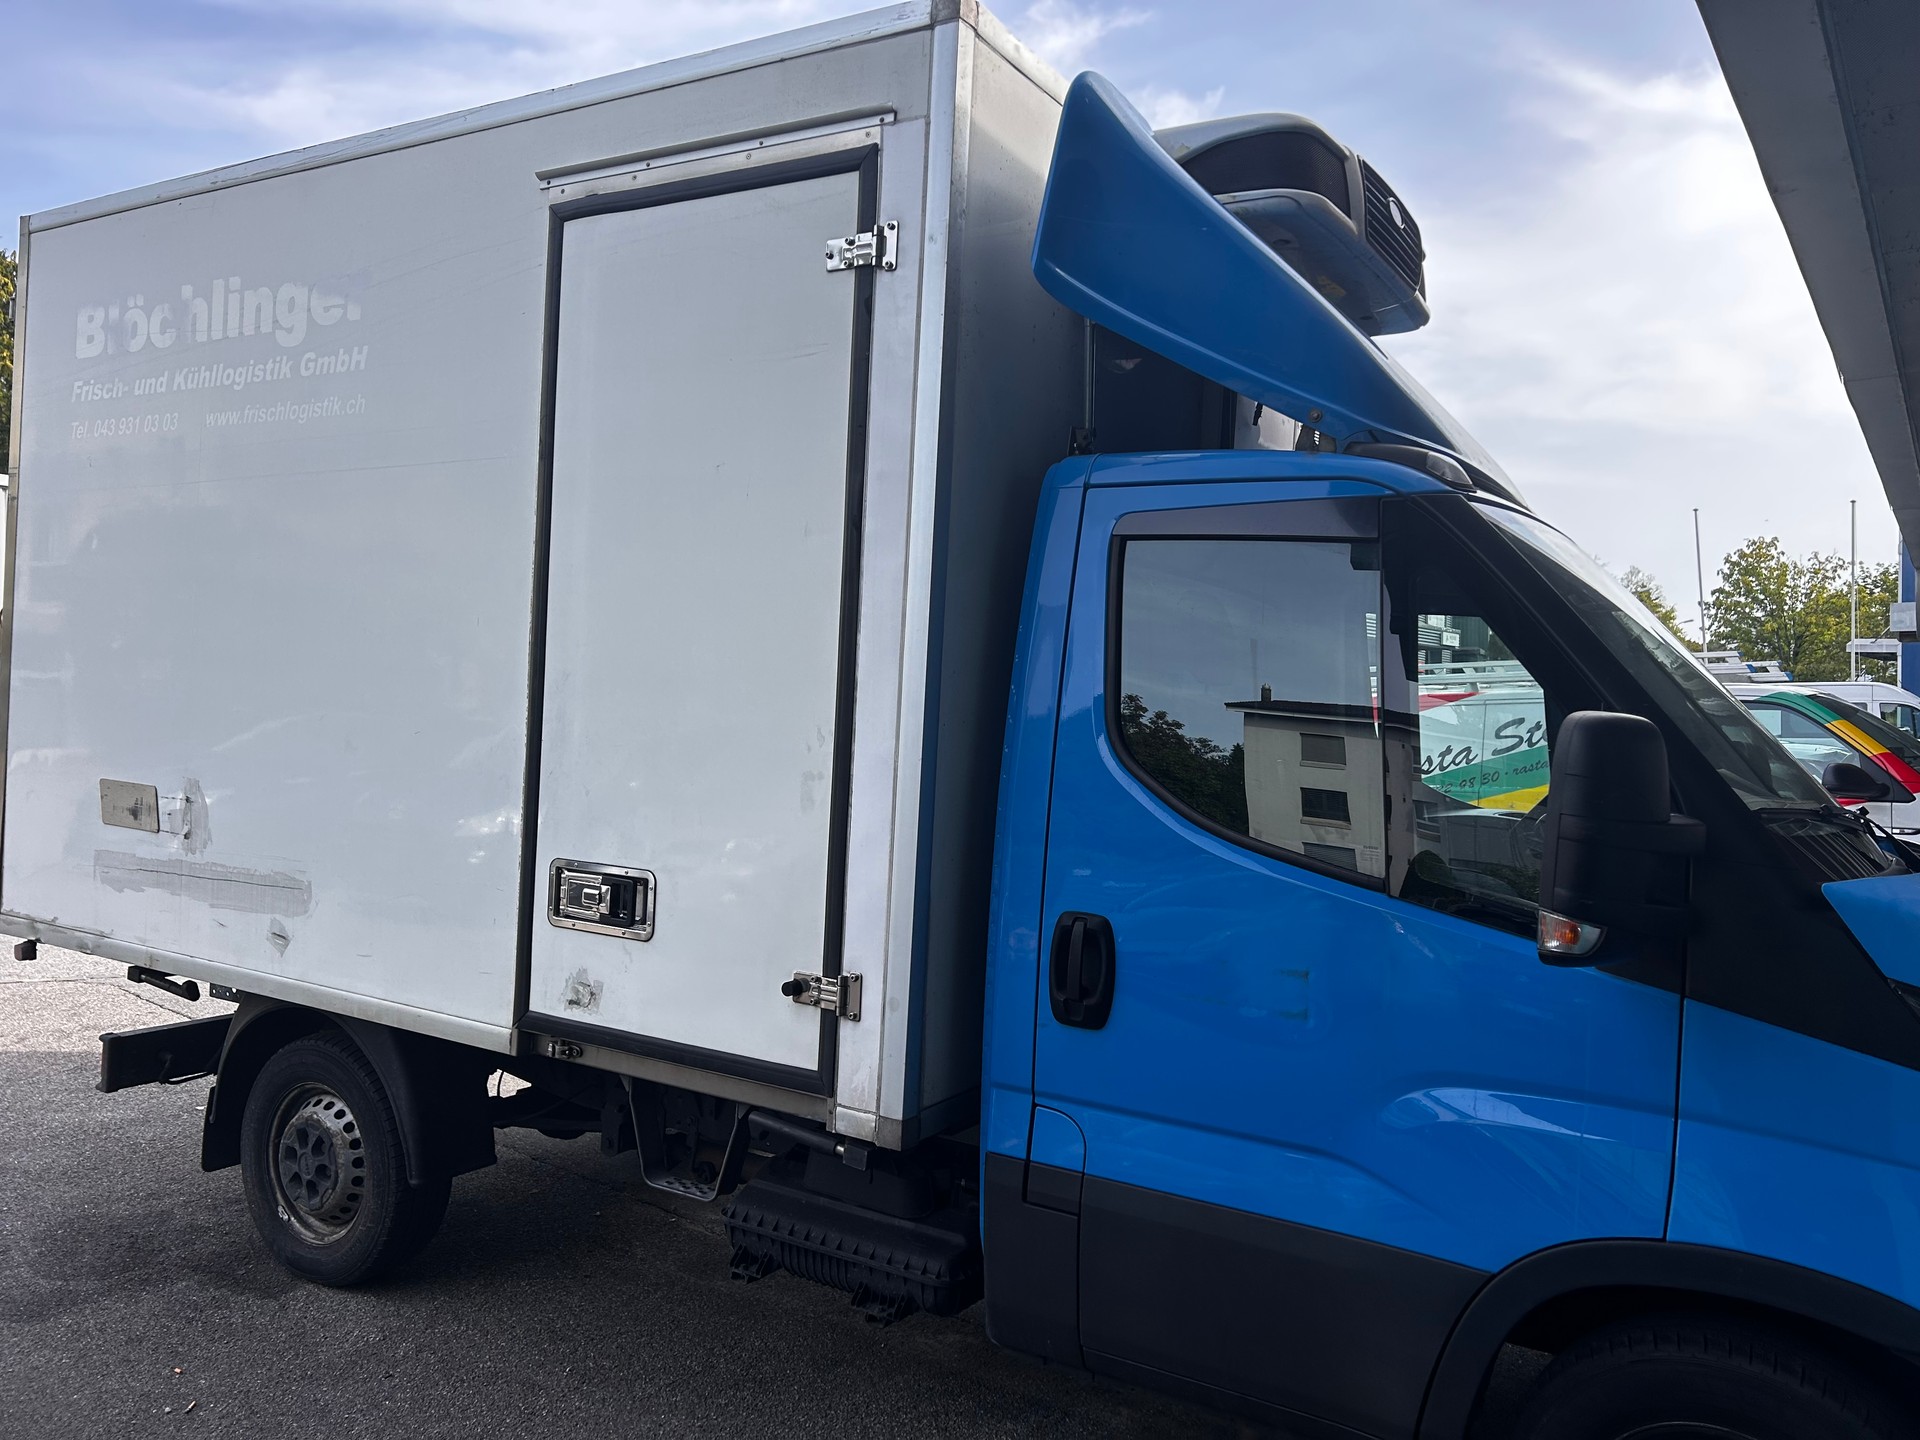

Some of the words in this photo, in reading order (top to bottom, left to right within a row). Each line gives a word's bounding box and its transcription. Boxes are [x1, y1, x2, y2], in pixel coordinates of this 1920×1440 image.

[71, 377, 129, 403] Frisch-
[134, 370, 168, 397] und
[172, 355, 294, 391] Kühllogistik
[299, 345, 369, 377] GmbH
[71, 421, 90, 440] Tel.
[94, 418, 116, 438] 043
[118, 415, 141, 436] 931
[143, 413, 161, 433] 03
[162, 411, 179, 431] 03
[205, 393, 366, 428] www.frischlogistik.ch
[1482, 770, 1501, 785] 30
